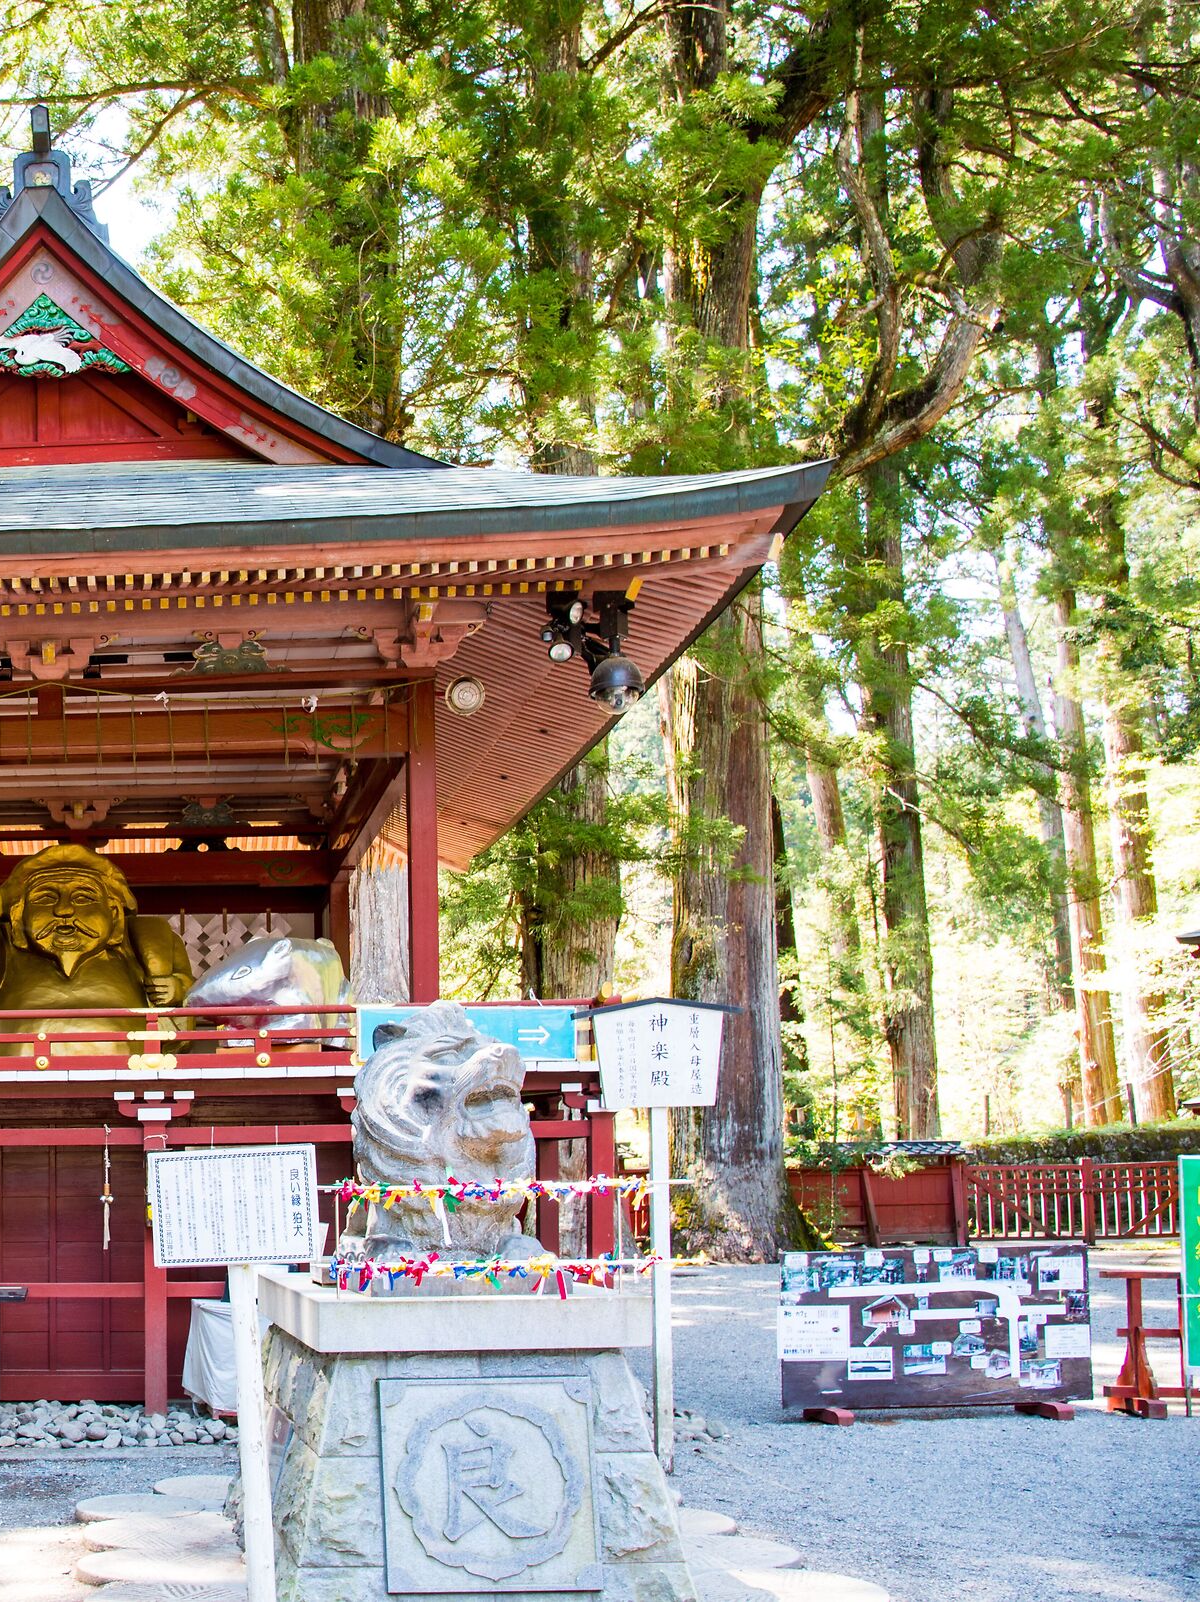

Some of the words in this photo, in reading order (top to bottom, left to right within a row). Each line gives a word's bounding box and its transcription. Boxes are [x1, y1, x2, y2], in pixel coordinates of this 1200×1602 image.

[648, 1013, 670, 1088] 神楽殿
[289, 1168, 302, 1208] 良い縁
[291, 1211, 304, 1238] 狛犬
[440, 1417, 549, 1543] 良
